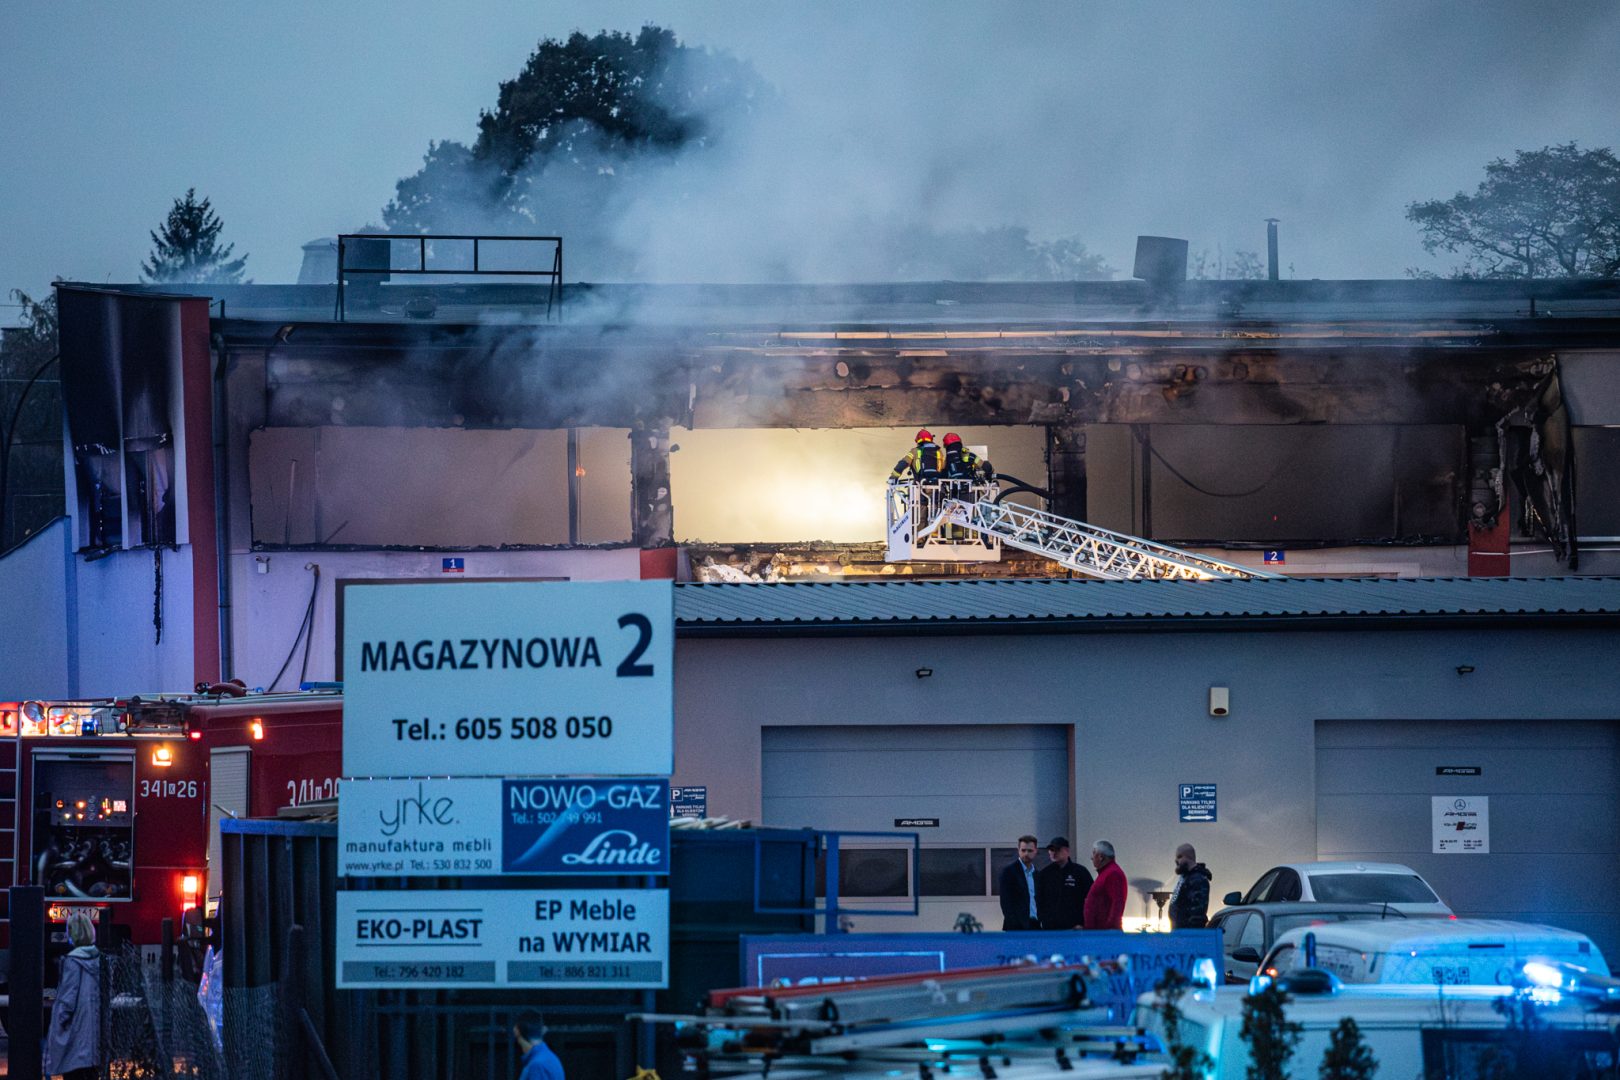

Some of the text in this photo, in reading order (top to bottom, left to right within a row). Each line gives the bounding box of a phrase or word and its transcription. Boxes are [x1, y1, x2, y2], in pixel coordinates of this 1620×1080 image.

[450, 558, 456, 569] 1
[1270, 551, 1278, 561] 2
[361, 613, 654, 678] MAGAZYNOWA 2
[392, 716, 613, 741] Tel.: 605 508 050
[510, 785, 661, 810] NOWO-GAZ
[673, 790, 681, 800] P
[1183, 787, 1191, 797] P
[512, 812, 534, 824] Tel.:
[537, 812, 557, 824] 502
[582, 811, 602, 823] 991
[346, 838, 492, 853] manufaktura mebli
[562, 829, 661, 865] Linde
[345, 861, 404, 873] www.yrke.pl
[410, 859, 430, 870] Tel.:
[433, 859, 451, 870] 530
[475, 859, 493, 870] 500
[535, 899, 636, 921] EP Meble
[356, 919, 483, 940] EKO-PLAST
[519, 931, 652, 953] na WYMIAR
[374, 966, 465, 978] Tel.: 796 420 182
